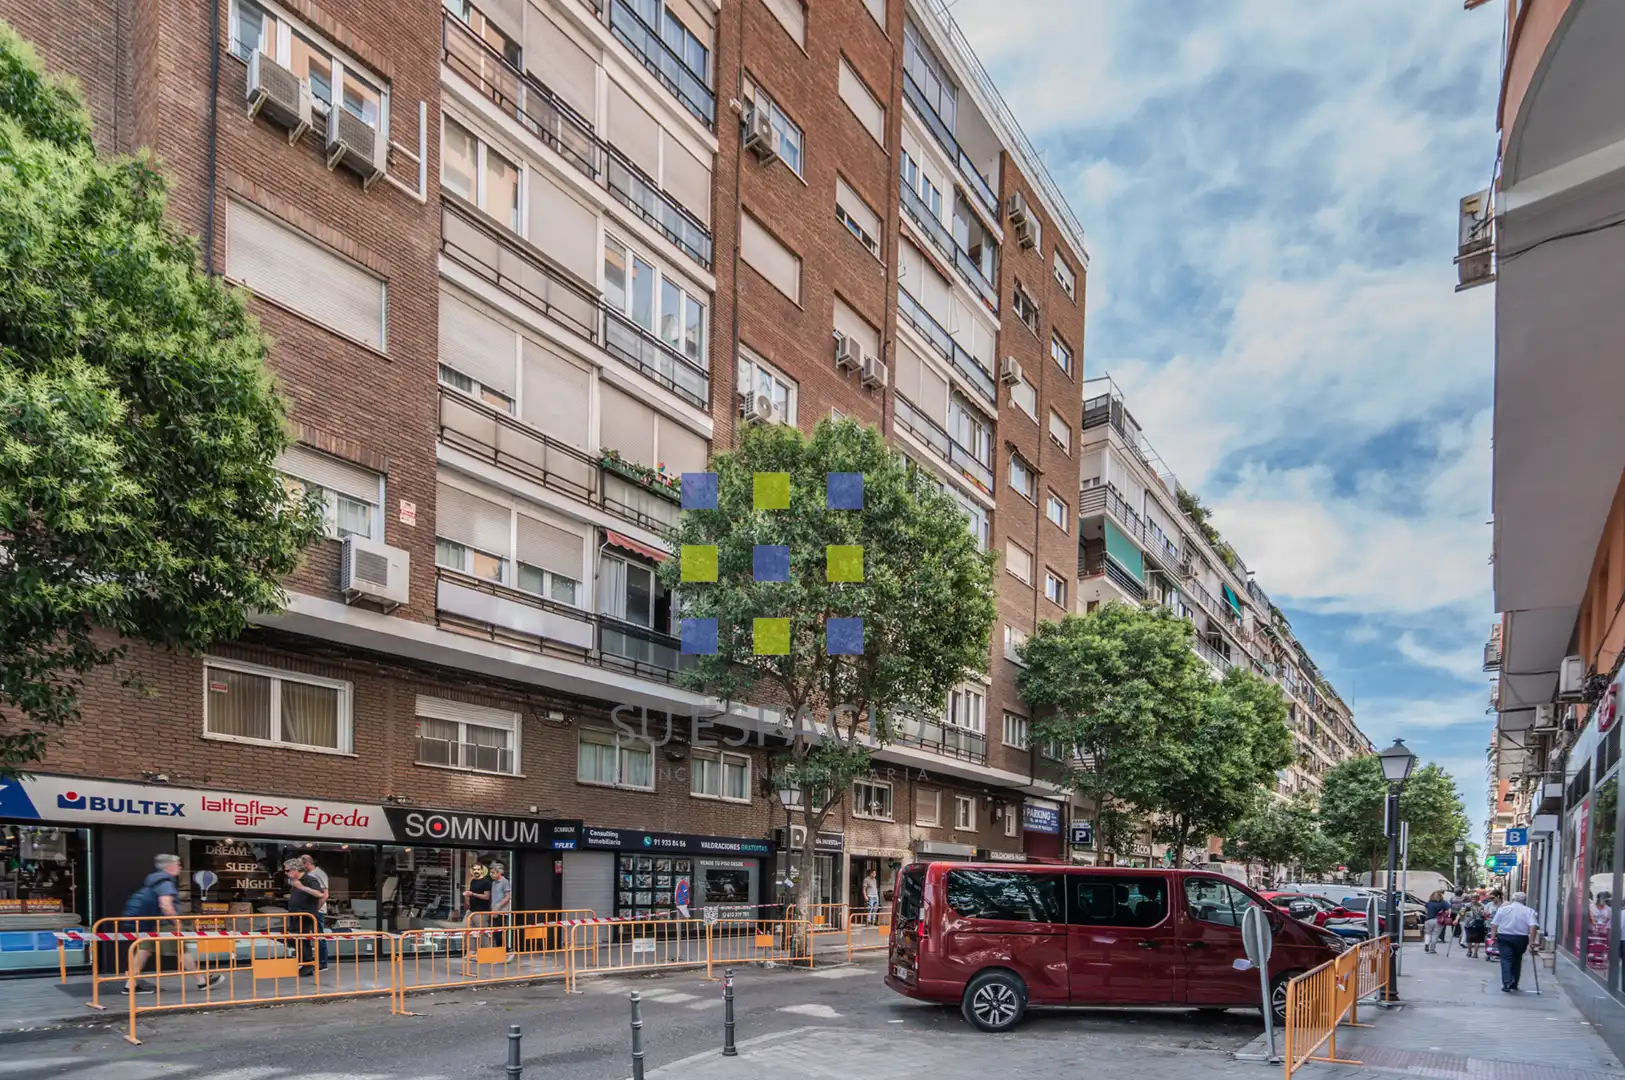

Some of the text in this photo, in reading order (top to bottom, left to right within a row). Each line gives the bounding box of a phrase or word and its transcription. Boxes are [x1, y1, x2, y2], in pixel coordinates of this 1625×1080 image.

[89, 796, 186, 818] BULTEX
[201, 795, 288, 817] lattoflex
[234, 813, 267, 826] air
[303, 805, 370, 831] Epeda
[1026, 808, 1051, 821] PARKING
[405, 813, 539, 844] SOMNIUM
[589, 829, 619, 839] Consulting
[1075, 830, 1087, 842] P
[1509, 831, 1521, 843] B
[653, 838, 661, 846] 91
[661, 839, 671, 847] 933
[701, 841, 768, 852] VALORACIONES GRATUITAS
[205, 845, 247, 856] DREAM
[225, 862, 258, 872] SLEEP
[236, 878, 275, 889] NIGHT
